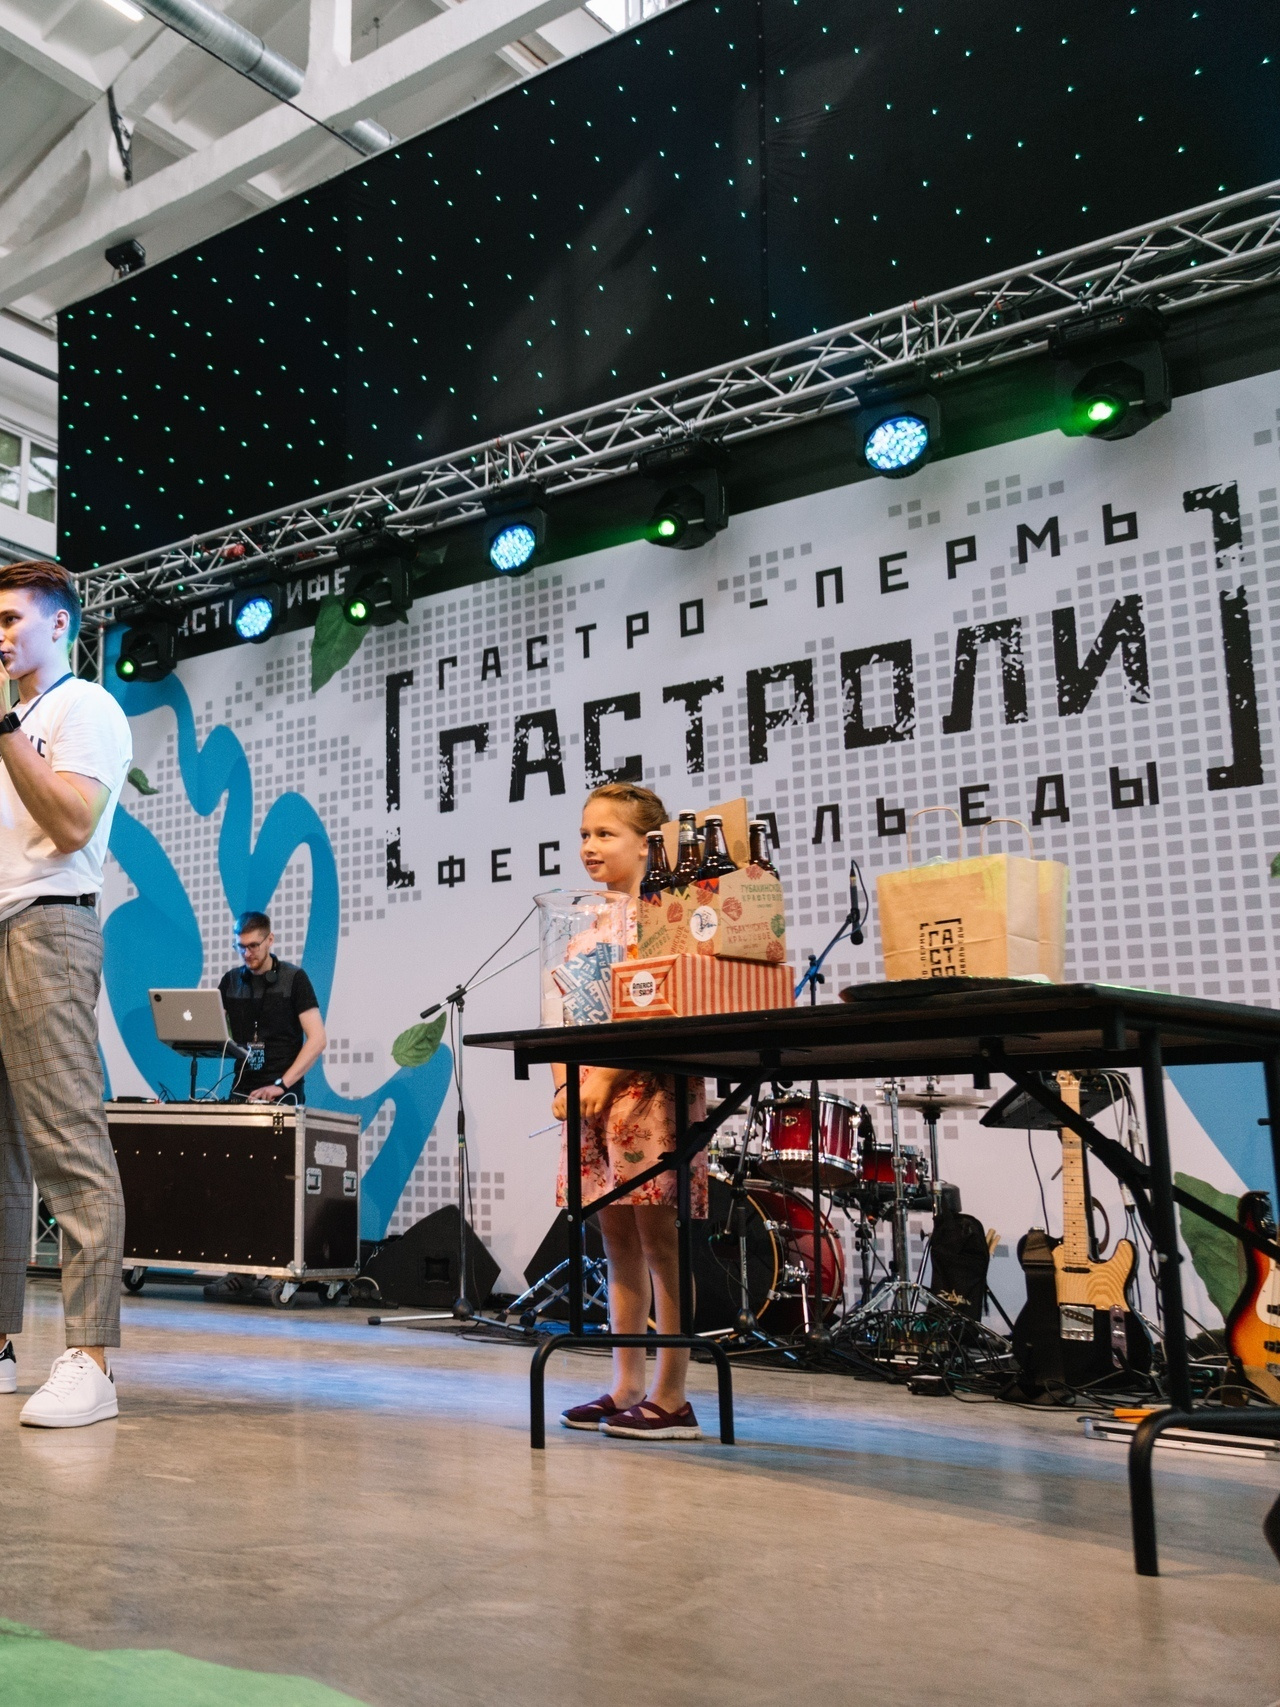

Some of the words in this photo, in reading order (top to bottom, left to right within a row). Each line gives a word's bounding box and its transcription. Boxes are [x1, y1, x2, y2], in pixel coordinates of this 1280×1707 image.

[439, 594, 1152, 813] ГАСТРОЛИ
[928, 928, 953, 947] ГА
[929, 947, 954, 965] СТ
[632, 981, 653, 990] AMERICA
